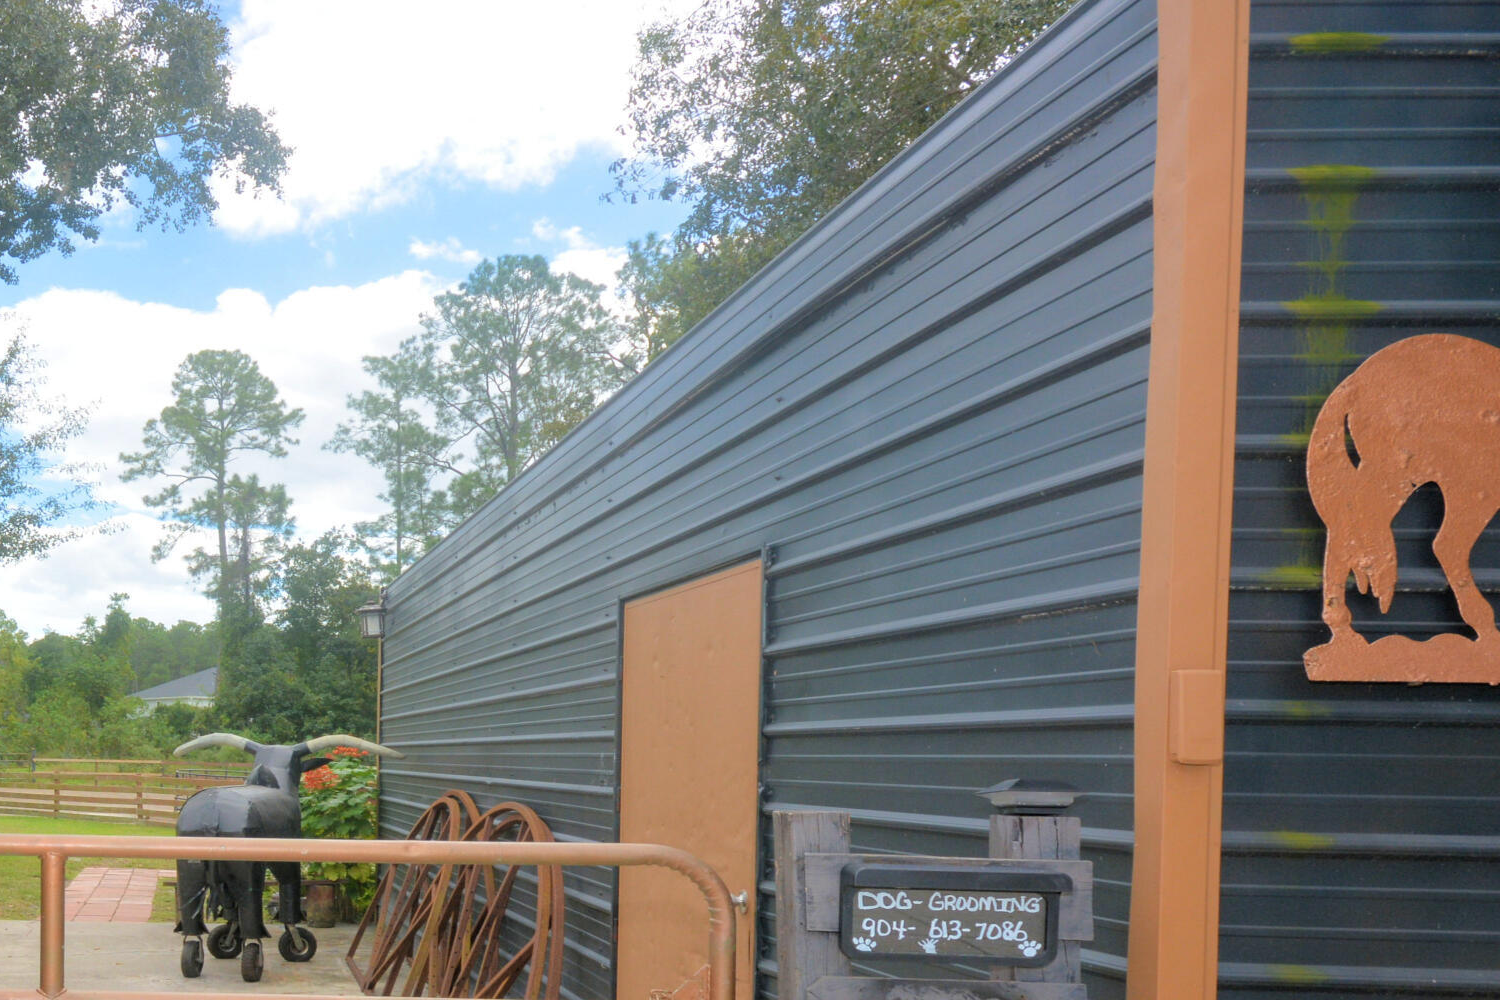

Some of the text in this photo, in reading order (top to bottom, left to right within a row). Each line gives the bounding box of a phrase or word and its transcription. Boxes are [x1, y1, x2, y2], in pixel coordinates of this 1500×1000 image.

[857, 891, 1043, 914] DOG- GROOMING
[862, 917, 916, 940] 904-
